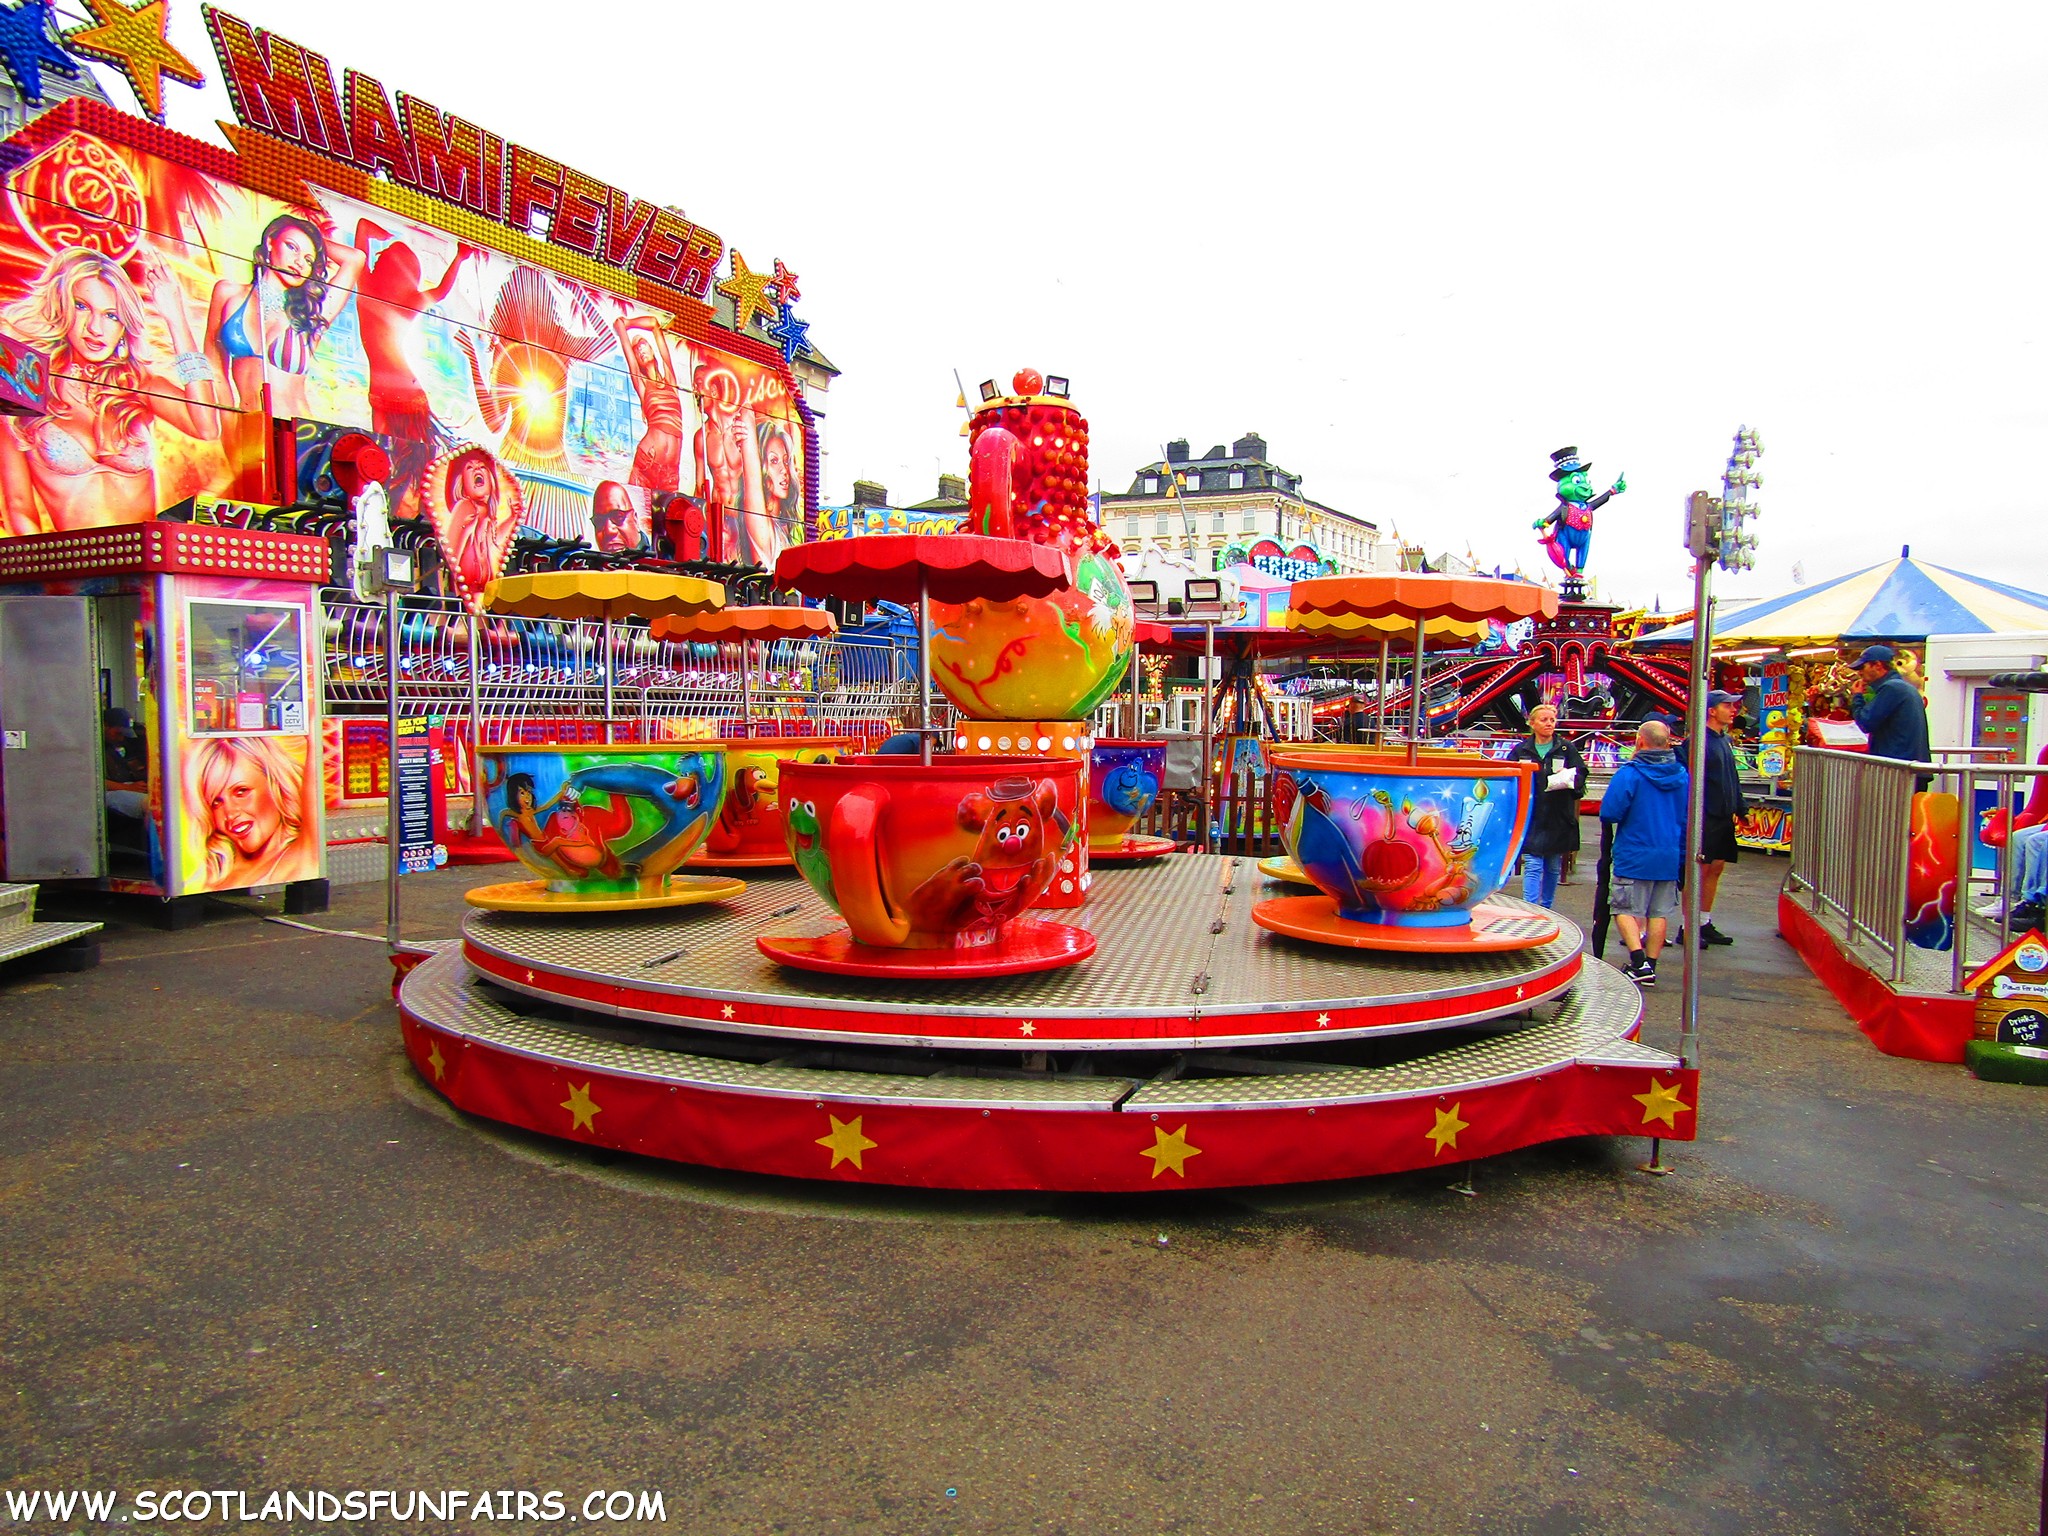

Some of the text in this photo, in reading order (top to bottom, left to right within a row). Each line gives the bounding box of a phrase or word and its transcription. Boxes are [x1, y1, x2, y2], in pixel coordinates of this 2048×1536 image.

[202, 4, 726, 299] MIAMI FEVER
[1763, 662, 1787, 679] HOOK
[1770, 677, 1780, 693] A
[1763, 692, 1787, 709] DUCK
[2008, 1014, 2037, 1026] Drinks
[2013, 1025, 2028, 1036] Are
[2021, 1030, 2037, 1042] Us!
